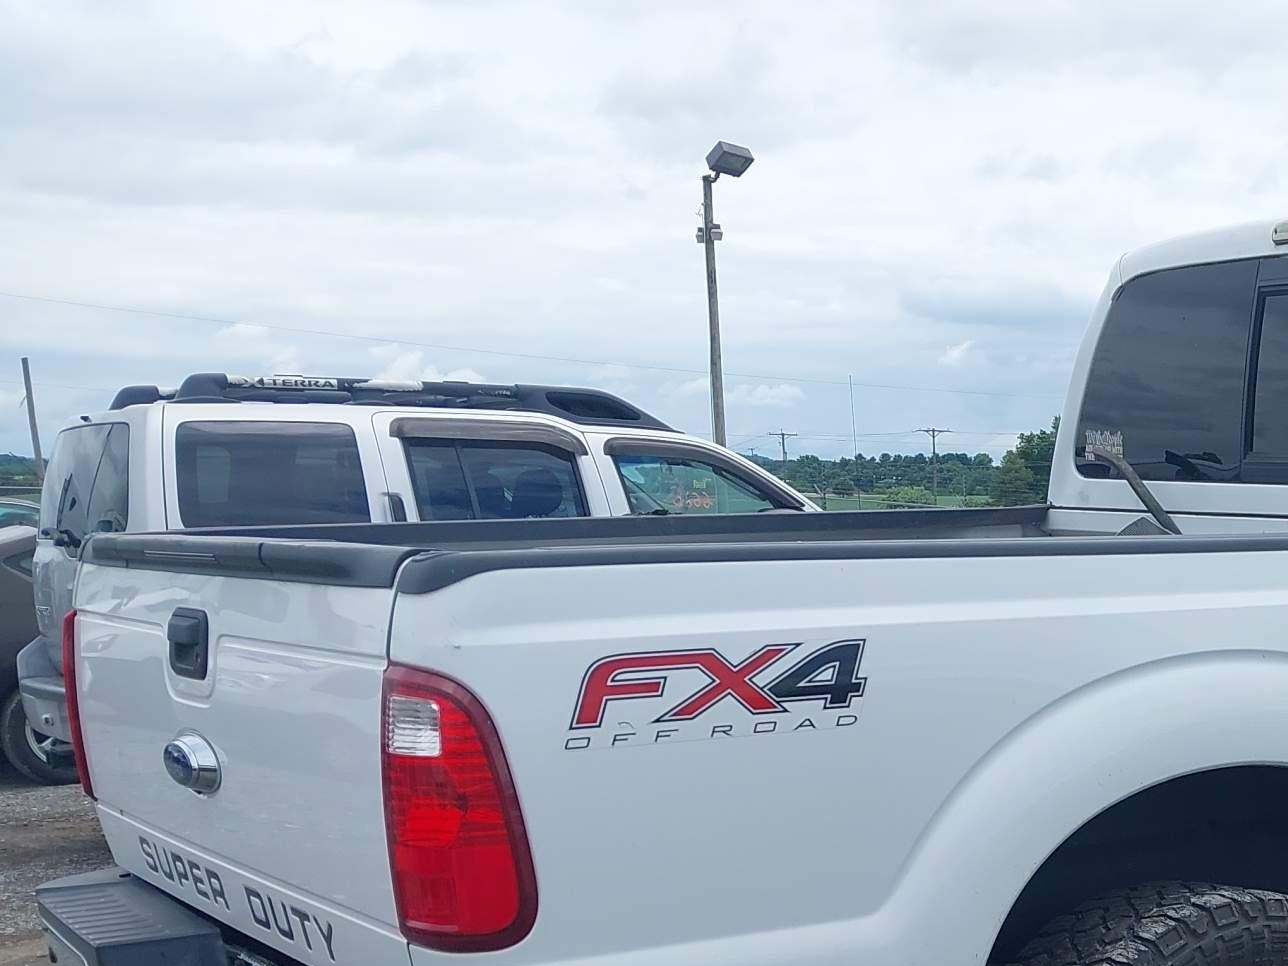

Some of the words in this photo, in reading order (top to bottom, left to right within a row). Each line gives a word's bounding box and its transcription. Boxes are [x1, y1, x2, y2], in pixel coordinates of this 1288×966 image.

[568, 638, 868, 731] FX4
[564, 728, 679, 751] OFF
[710, 714, 859, 739] ROAD
[138, 835, 231, 913] SUPER
[243, 883, 336, 964] DUTY
